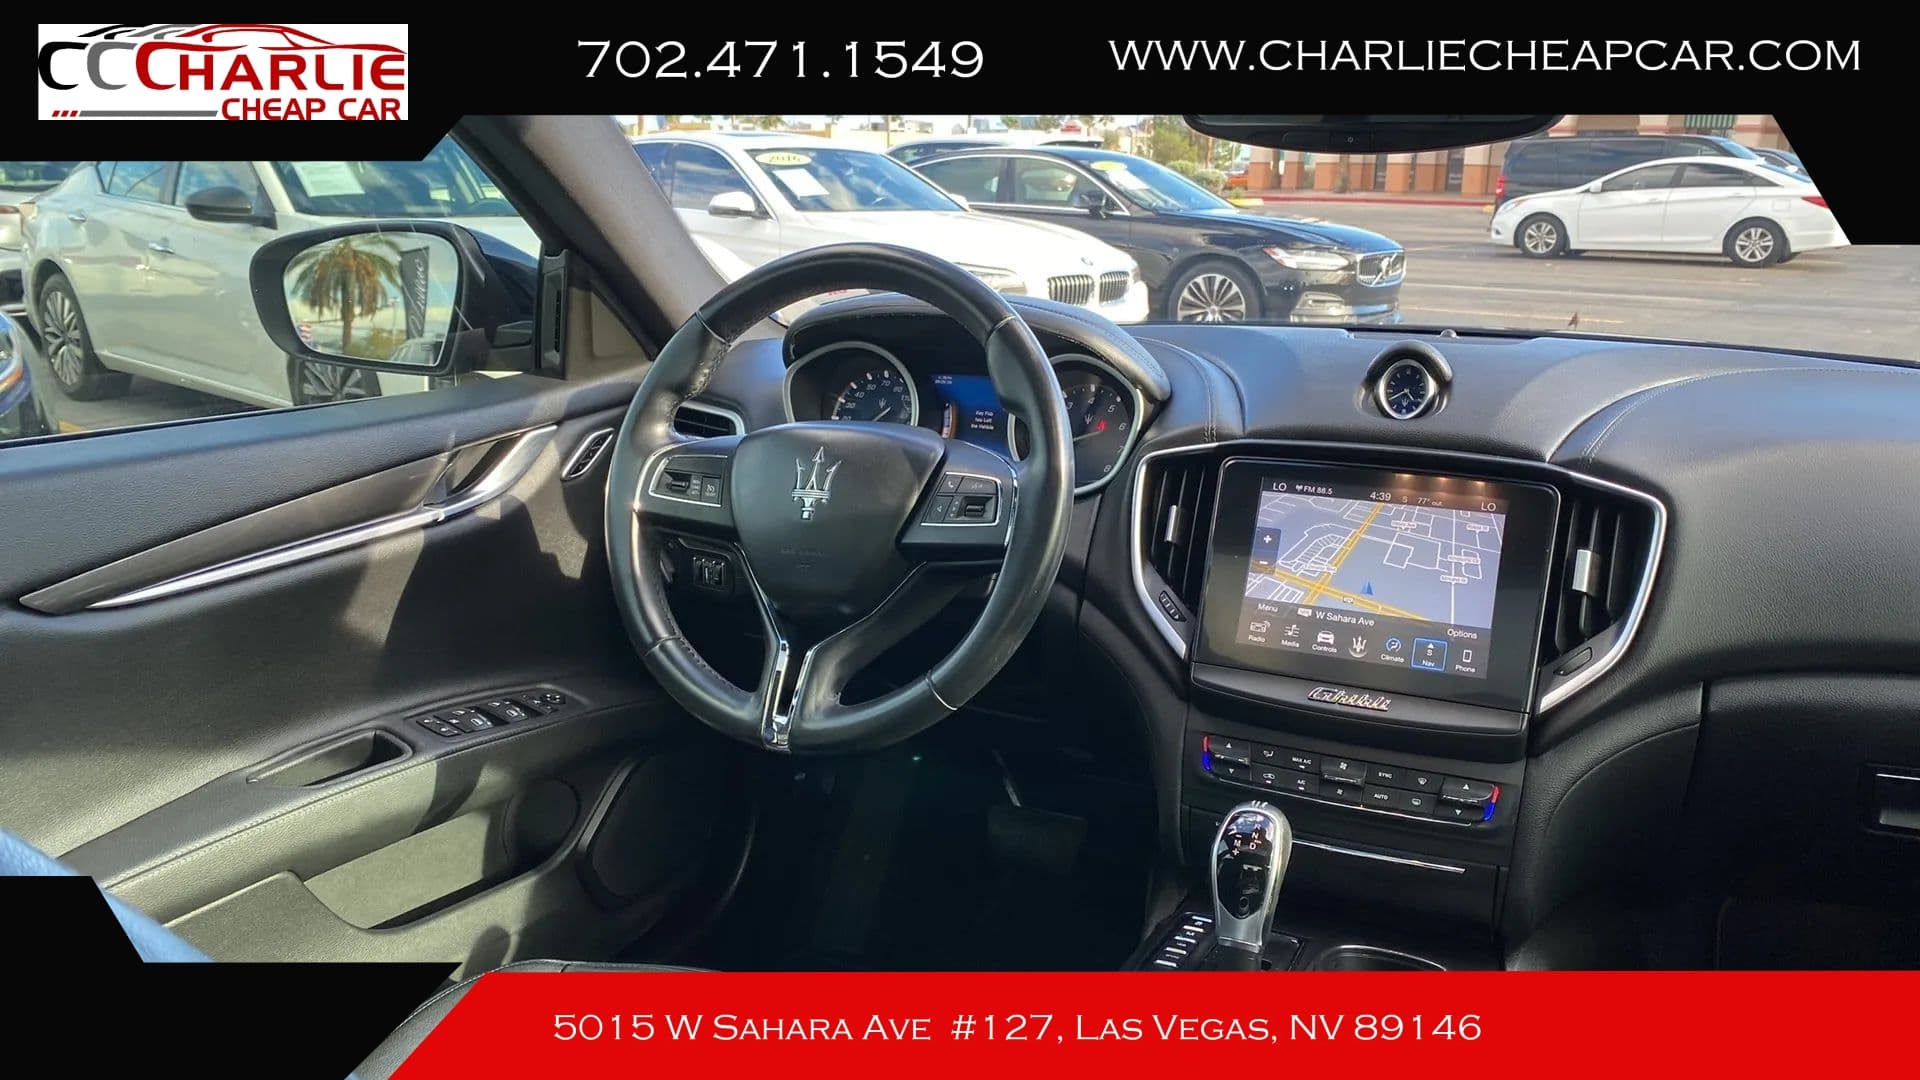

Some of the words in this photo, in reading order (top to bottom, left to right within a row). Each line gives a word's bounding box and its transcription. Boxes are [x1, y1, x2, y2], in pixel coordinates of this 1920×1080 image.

[1272, 482, 1287, 492] LO
[1369, 491, 1392, 502] 4:39
[1480, 502, 1497, 512] LO
[1257, 603, 1279, 613] Menu
[1315, 611, 1325, 620] W
[1326, 612, 1357, 624] Sahara
[1357, 616, 1375, 627] Ave
[1248, 634, 1266, 644] Radio
[1446, 628, 1478, 641] Options
[1281, 638, 1300, 648] Media
[1311, 643, 1337, 654] Controls
[1380, 653, 1405, 664] Climate
[1421, 659, 1435, 668] Nav
[1454, 663, 1476, 674] Phone
[1374, 792, 1388, 800] AUTO
